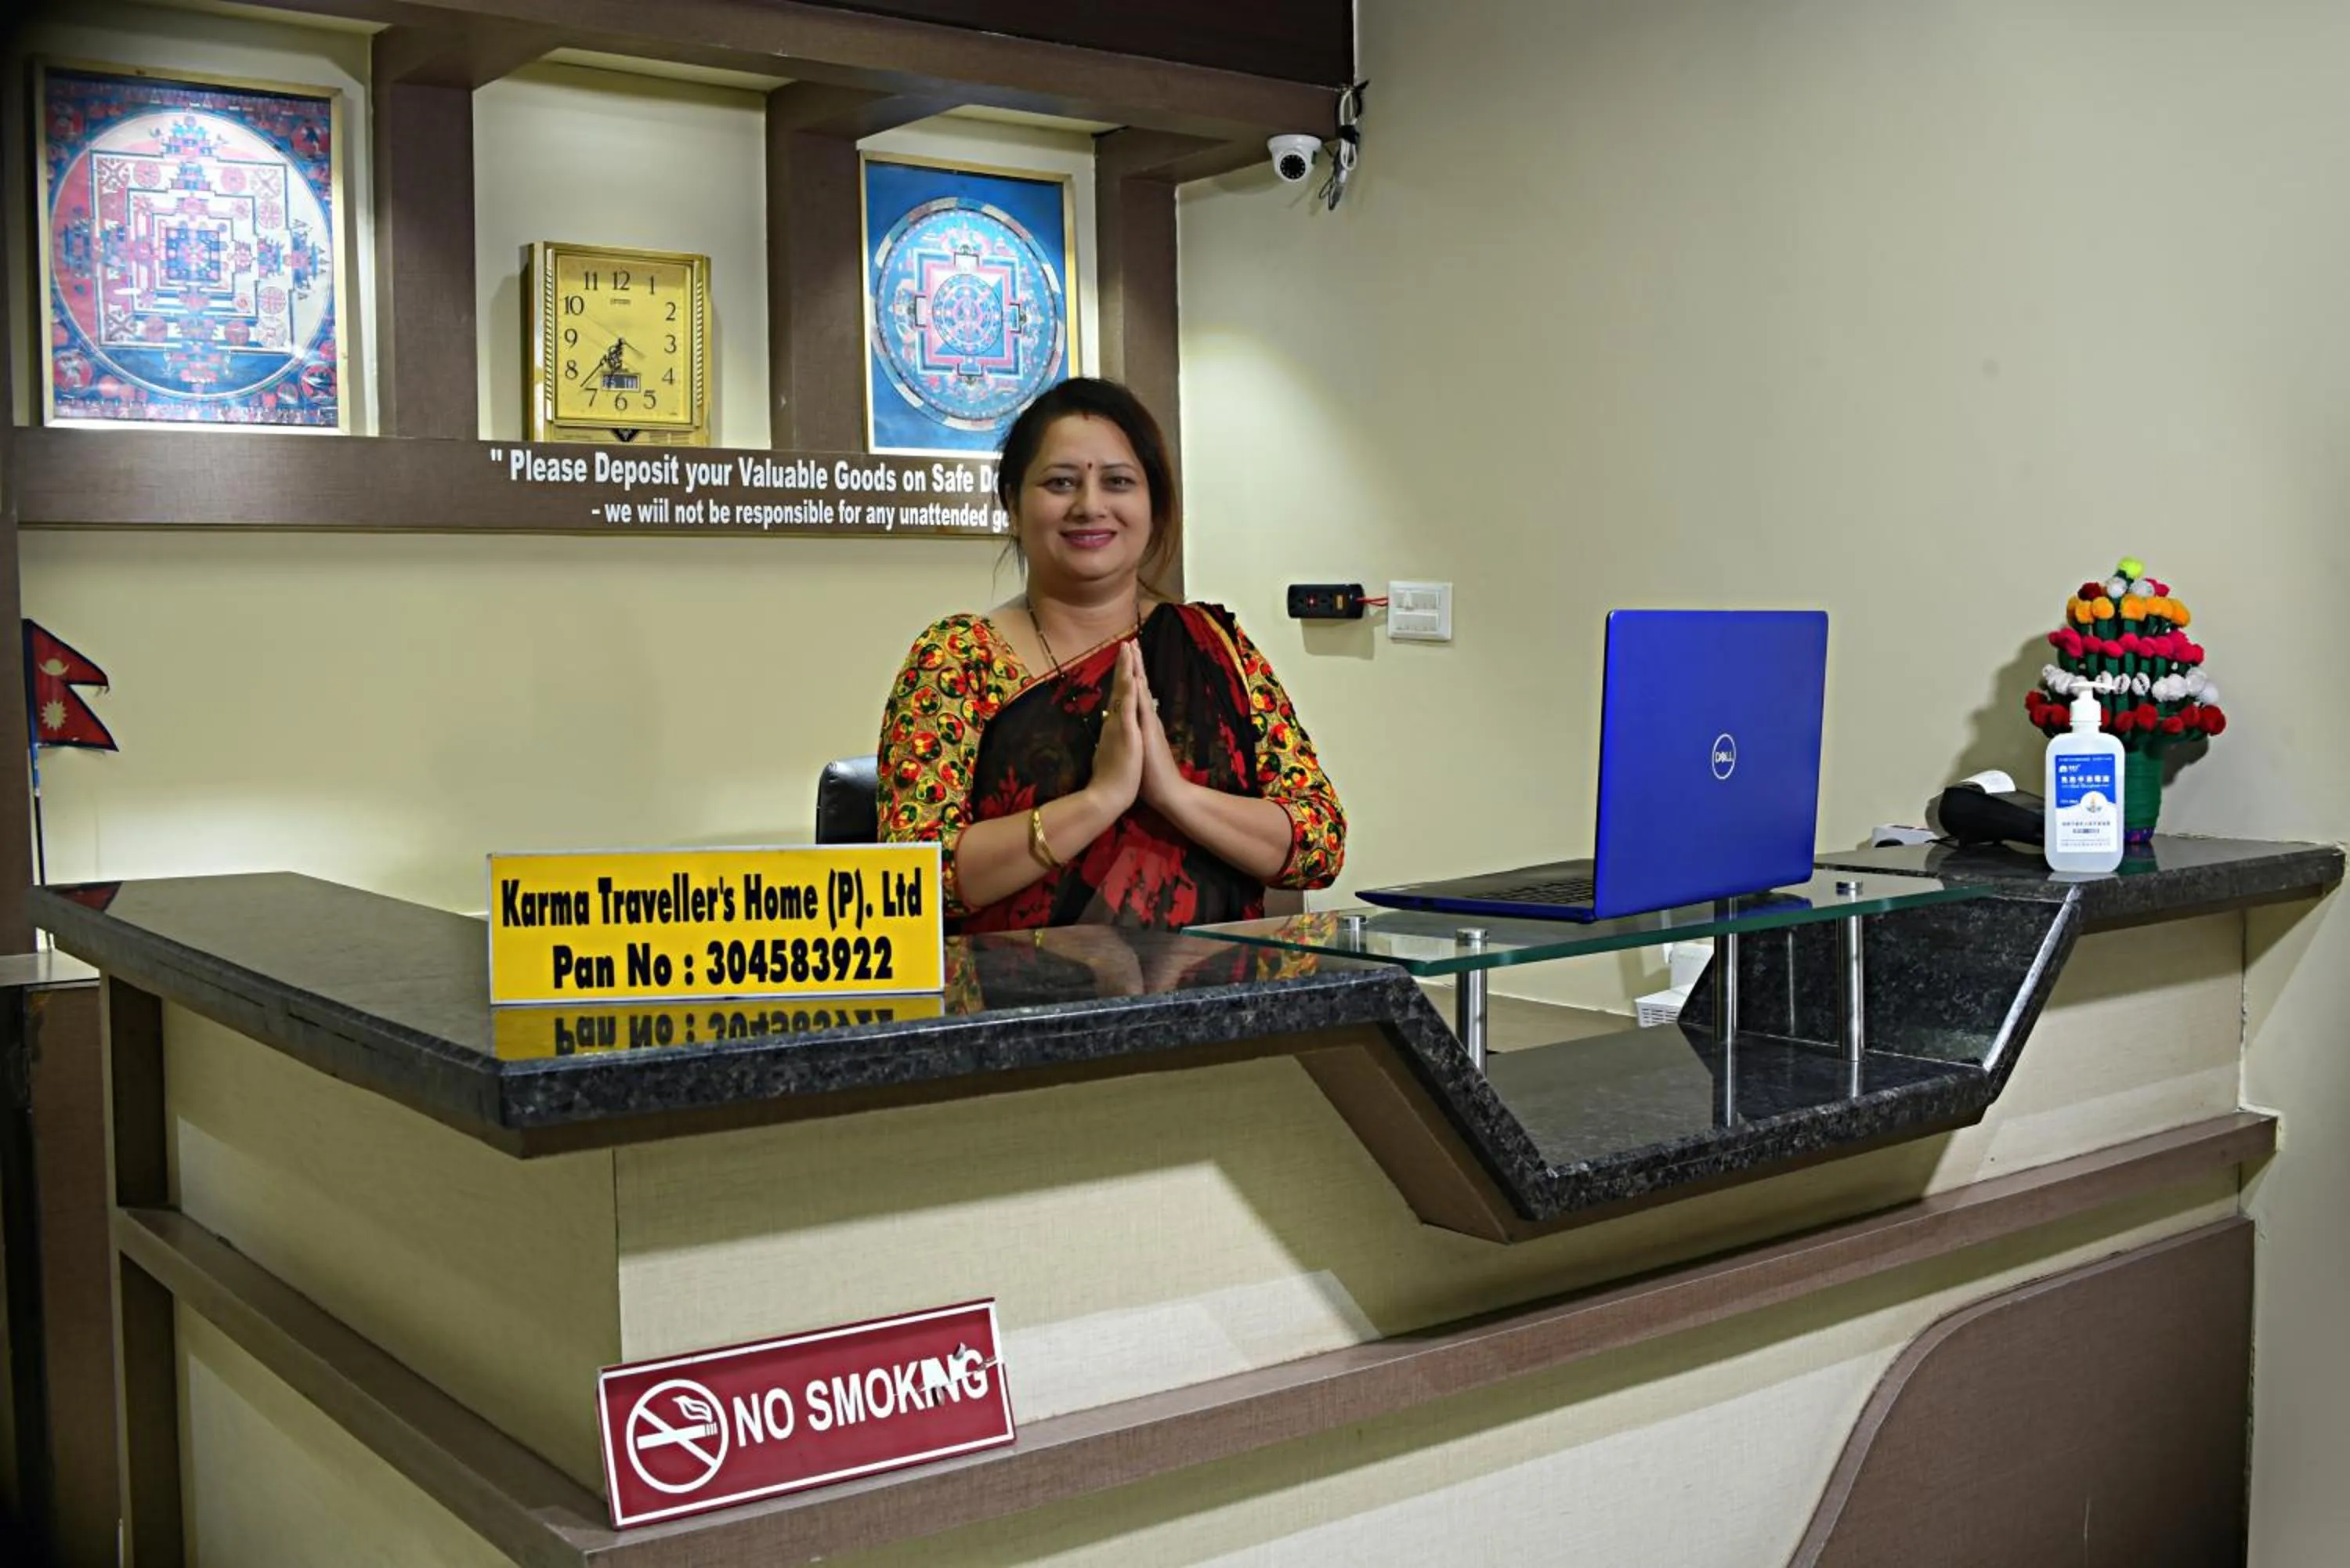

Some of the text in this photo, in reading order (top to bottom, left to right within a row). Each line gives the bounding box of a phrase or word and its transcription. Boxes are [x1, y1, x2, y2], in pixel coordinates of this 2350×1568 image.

[584, 271, 598, 291] 11
[613, 270, 631, 291] 12
[649, 276, 655, 295] 1
[564, 295, 584, 316] 10
[665, 302, 677, 321] 2
[564, 328, 577, 349] 9
[664, 334, 677, 353] 3
[565, 359, 578, 380] 8
[662, 367, 675, 385] 4
[584, 388, 598, 407] 7
[615, 392, 627, 411] 6
[643, 390, 656, 409] 5
[510, 449, 587, 482] Please
[595, 451, 679, 491] Deposit
[685, 462, 732, 493] your
[738, 457, 828, 490] Valuable
[834, 461, 897, 491] Goods
[902, 469, 926, 492] on
[931, 463, 974, 493] Safe
[605, 504, 631, 522] we
[674, 500, 703, 523] not
[709, 499, 731, 523] be
[736, 499, 834, 530] responsible
[838, 499, 862, 523] for
[866, 505, 895, 531] any
[900, 503, 988, 527] unattended
[501, 867, 922, 932] Karma Traveller's Home (P). Ltd
[553, 945, 615, 989] Pan
[627, 942, 672, 987] No
[706, 936, 893, 985] 304583922
[732, 1349, 989, 1448] NO SMOKING
